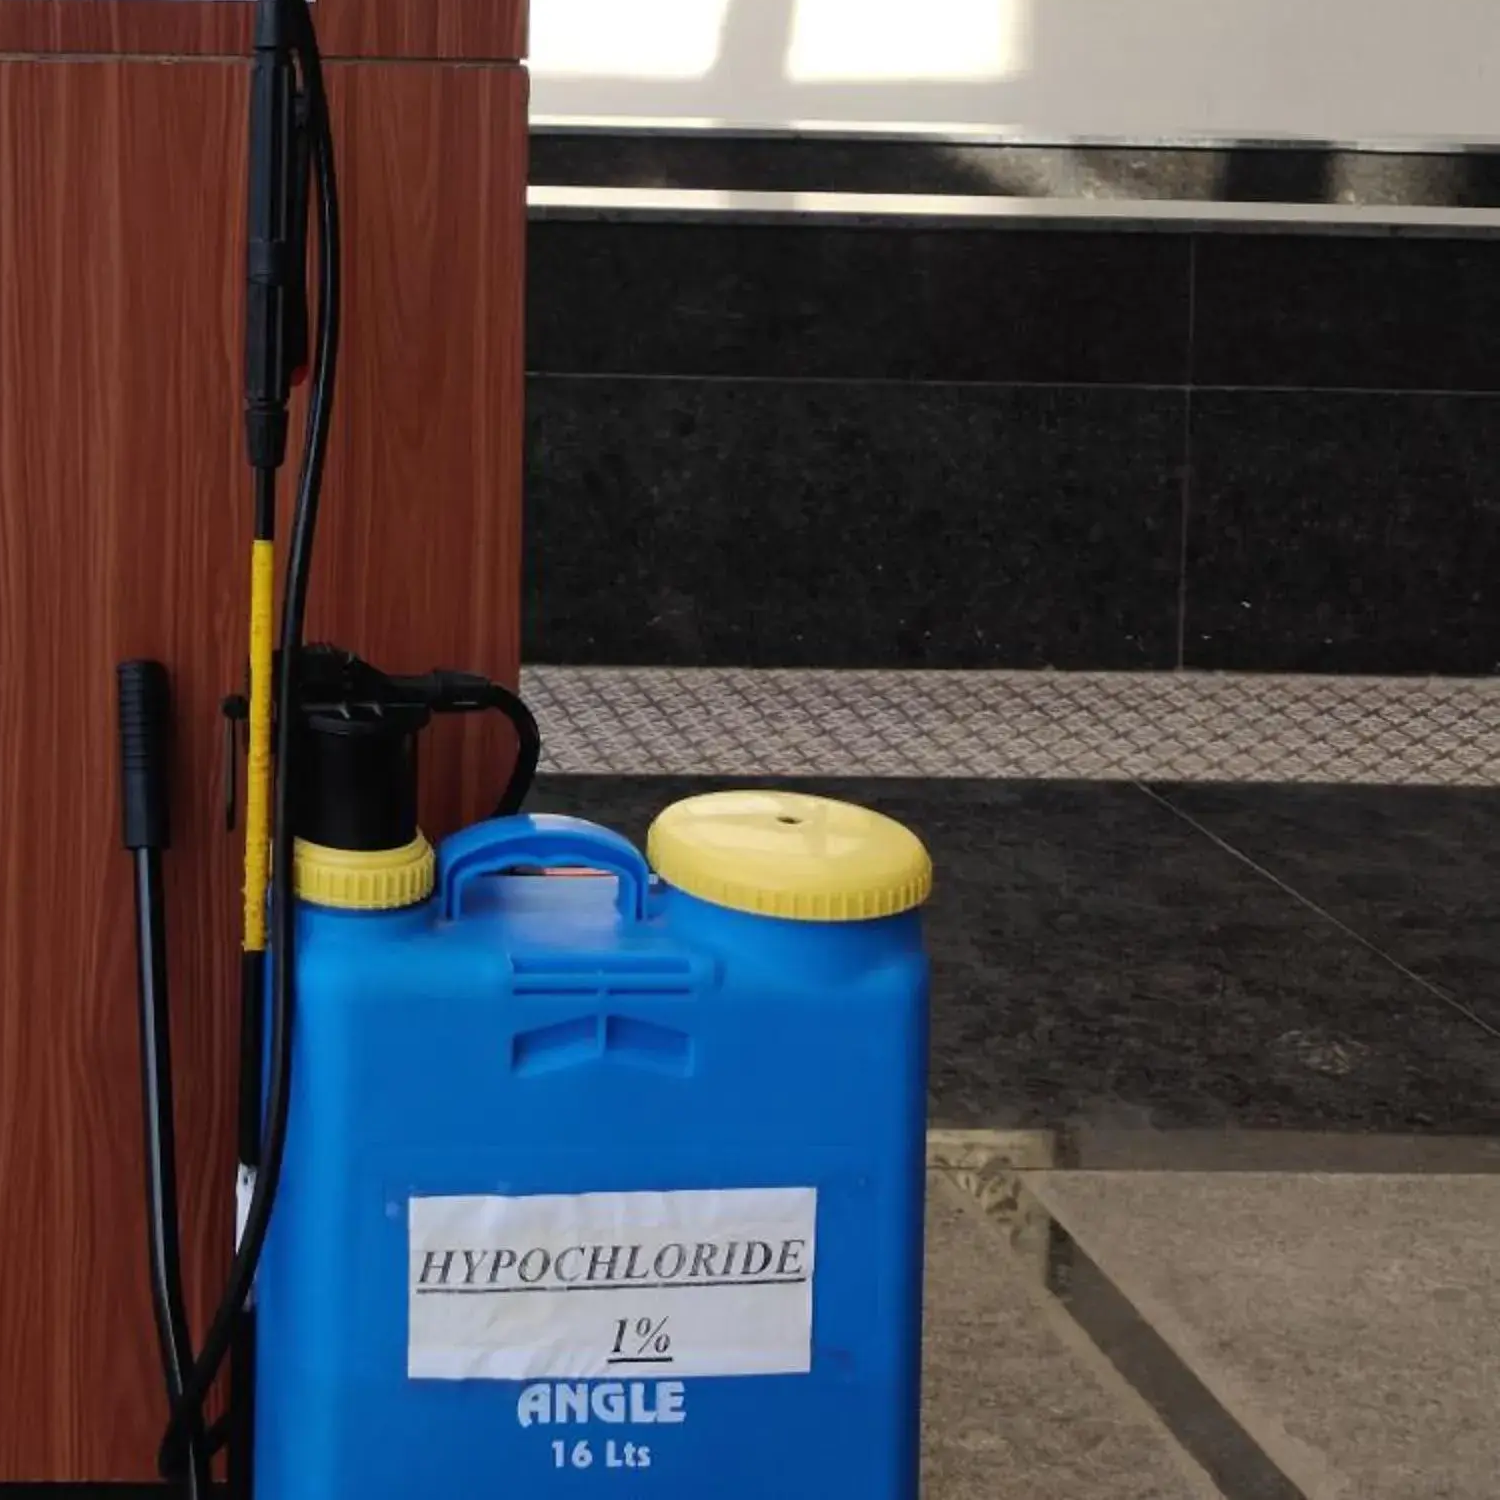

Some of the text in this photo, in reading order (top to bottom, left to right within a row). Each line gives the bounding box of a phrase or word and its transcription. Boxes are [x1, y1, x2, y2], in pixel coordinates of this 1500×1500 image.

[417, 1238, 807, 1288] HYPOCHLORIDE
[609, 1315, 672, 1355] 1%
[517, 1380, 686, 1427] ANGLE
[551, 1439, 651, 1468] 16 Lts
